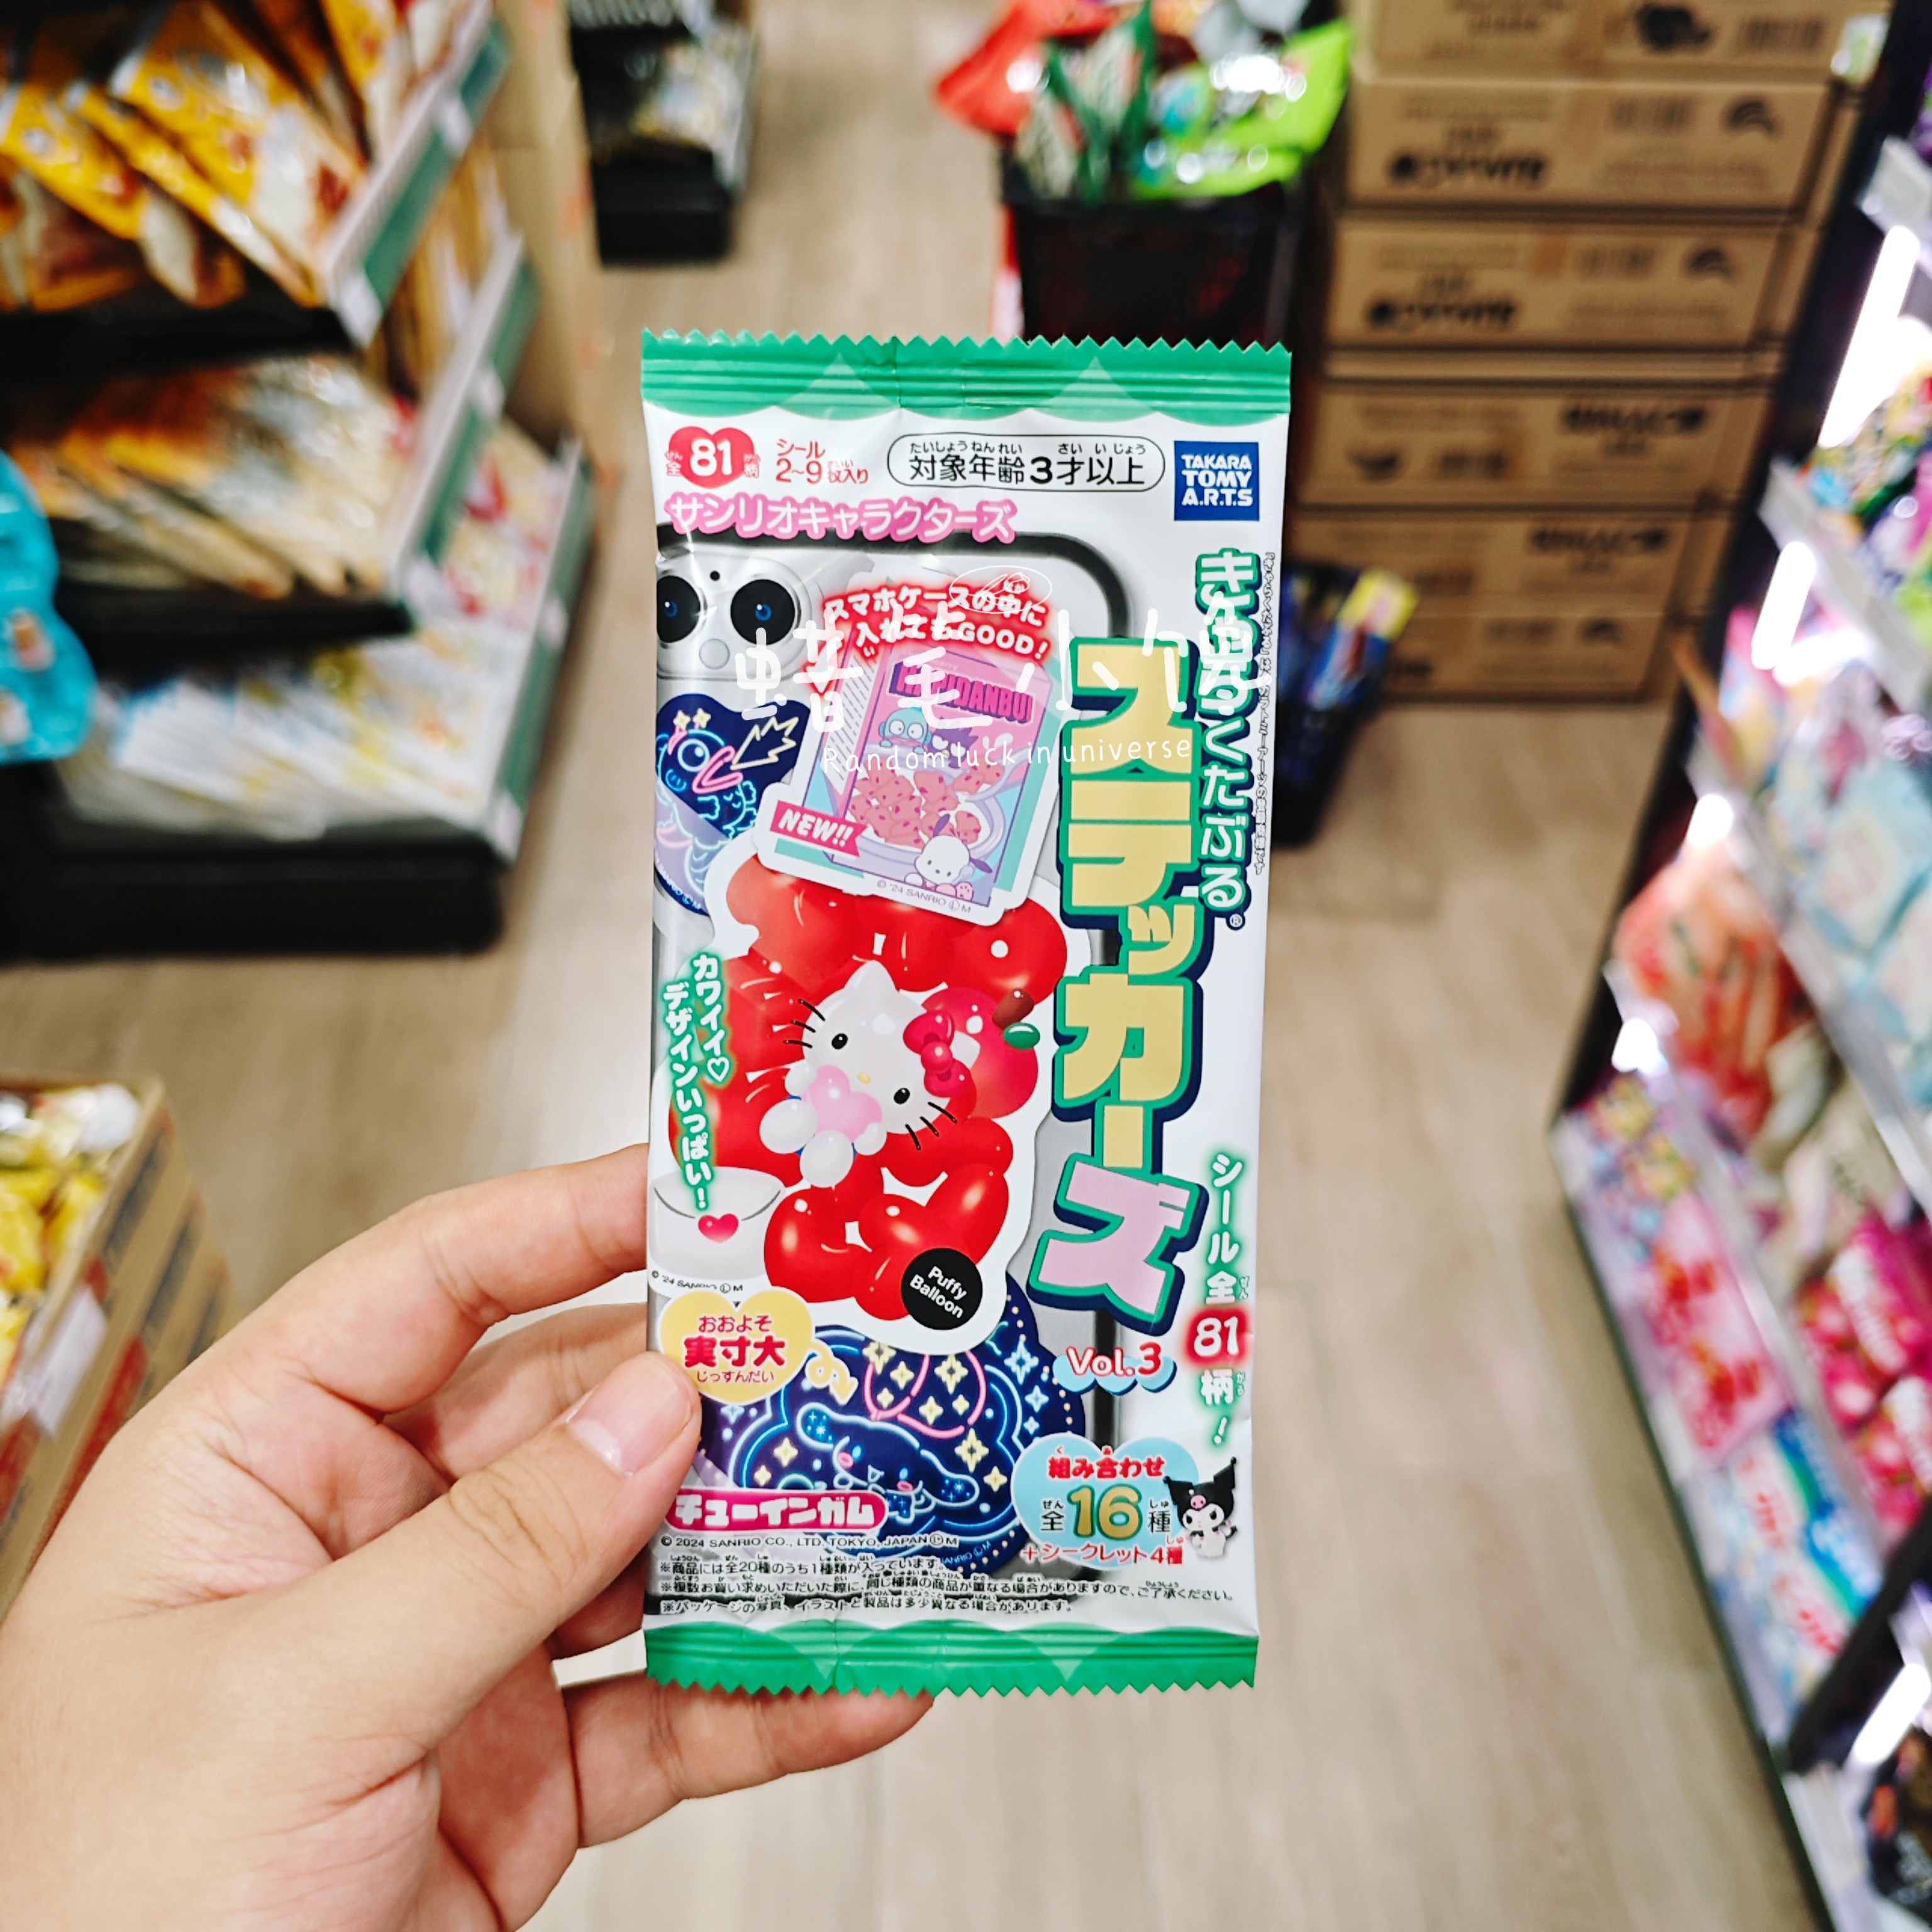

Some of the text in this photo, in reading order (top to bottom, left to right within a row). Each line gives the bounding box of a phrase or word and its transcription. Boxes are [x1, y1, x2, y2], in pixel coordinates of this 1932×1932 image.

[775, 438, 826, 459] シール
[1181, 453, 1252, 470] TAKARA
[908, 455, 1146, 486] 対象年齢3才以上
[1181, 469, 1252, 487] TOMY
[667, 494, 1016, 543] サンリオキャラクターズ
[777, 808, 856, 848] NEW!!
[906, 888, 947, 906] SANRIO
[1034, 638, 1205, 1331] ステッカーズ
[909, 1274, 963, 1319] Balloon
[928, 1265, 967, 1301] Puffy
[697, 1314, 773, 1333] おおよそ
[683, 1335, 786, 1368] 実寸大
[1066, 1341, 1162, 1377] Vol.3
[696, 1370, 775, 1384] じっすんだい
[1047, 1456, 1165, 1479] 組み合わせ
[675, 1494, 875, 1526] チューインガム
[675, 1538, 705, 1547] 2024
[709, 1538, 762, 1548] SANRIO
[765, 1537, 793, 1548] CO.,
[830, 1538, 880, 1548] TOKYO,
